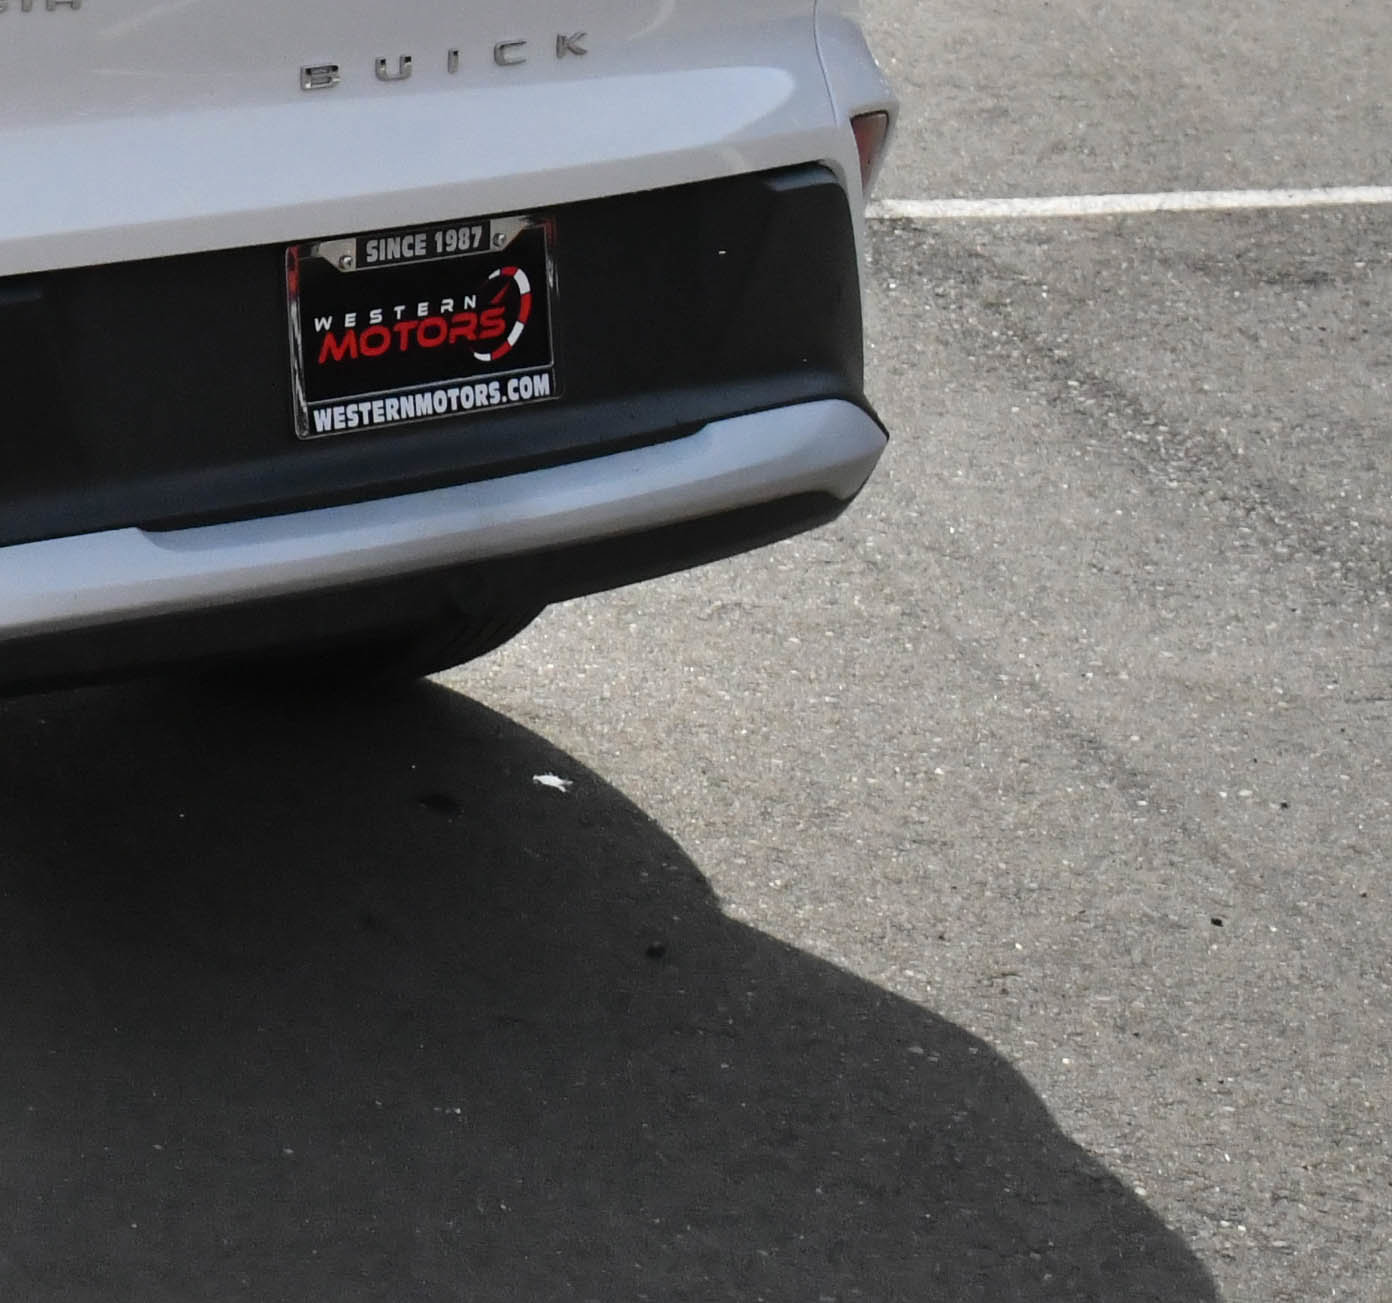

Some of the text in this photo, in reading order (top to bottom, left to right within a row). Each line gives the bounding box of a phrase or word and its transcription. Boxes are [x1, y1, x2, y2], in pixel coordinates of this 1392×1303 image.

[300, 31, 588, 91] BUICK
[366, 226, 483, 263] SINCE 1987
[314, 295, 477, 332] WESTERN
[318, 307, 507, 364] MOTORS
[313, 373, 550, 433] WESTERNMOTORS.COM
